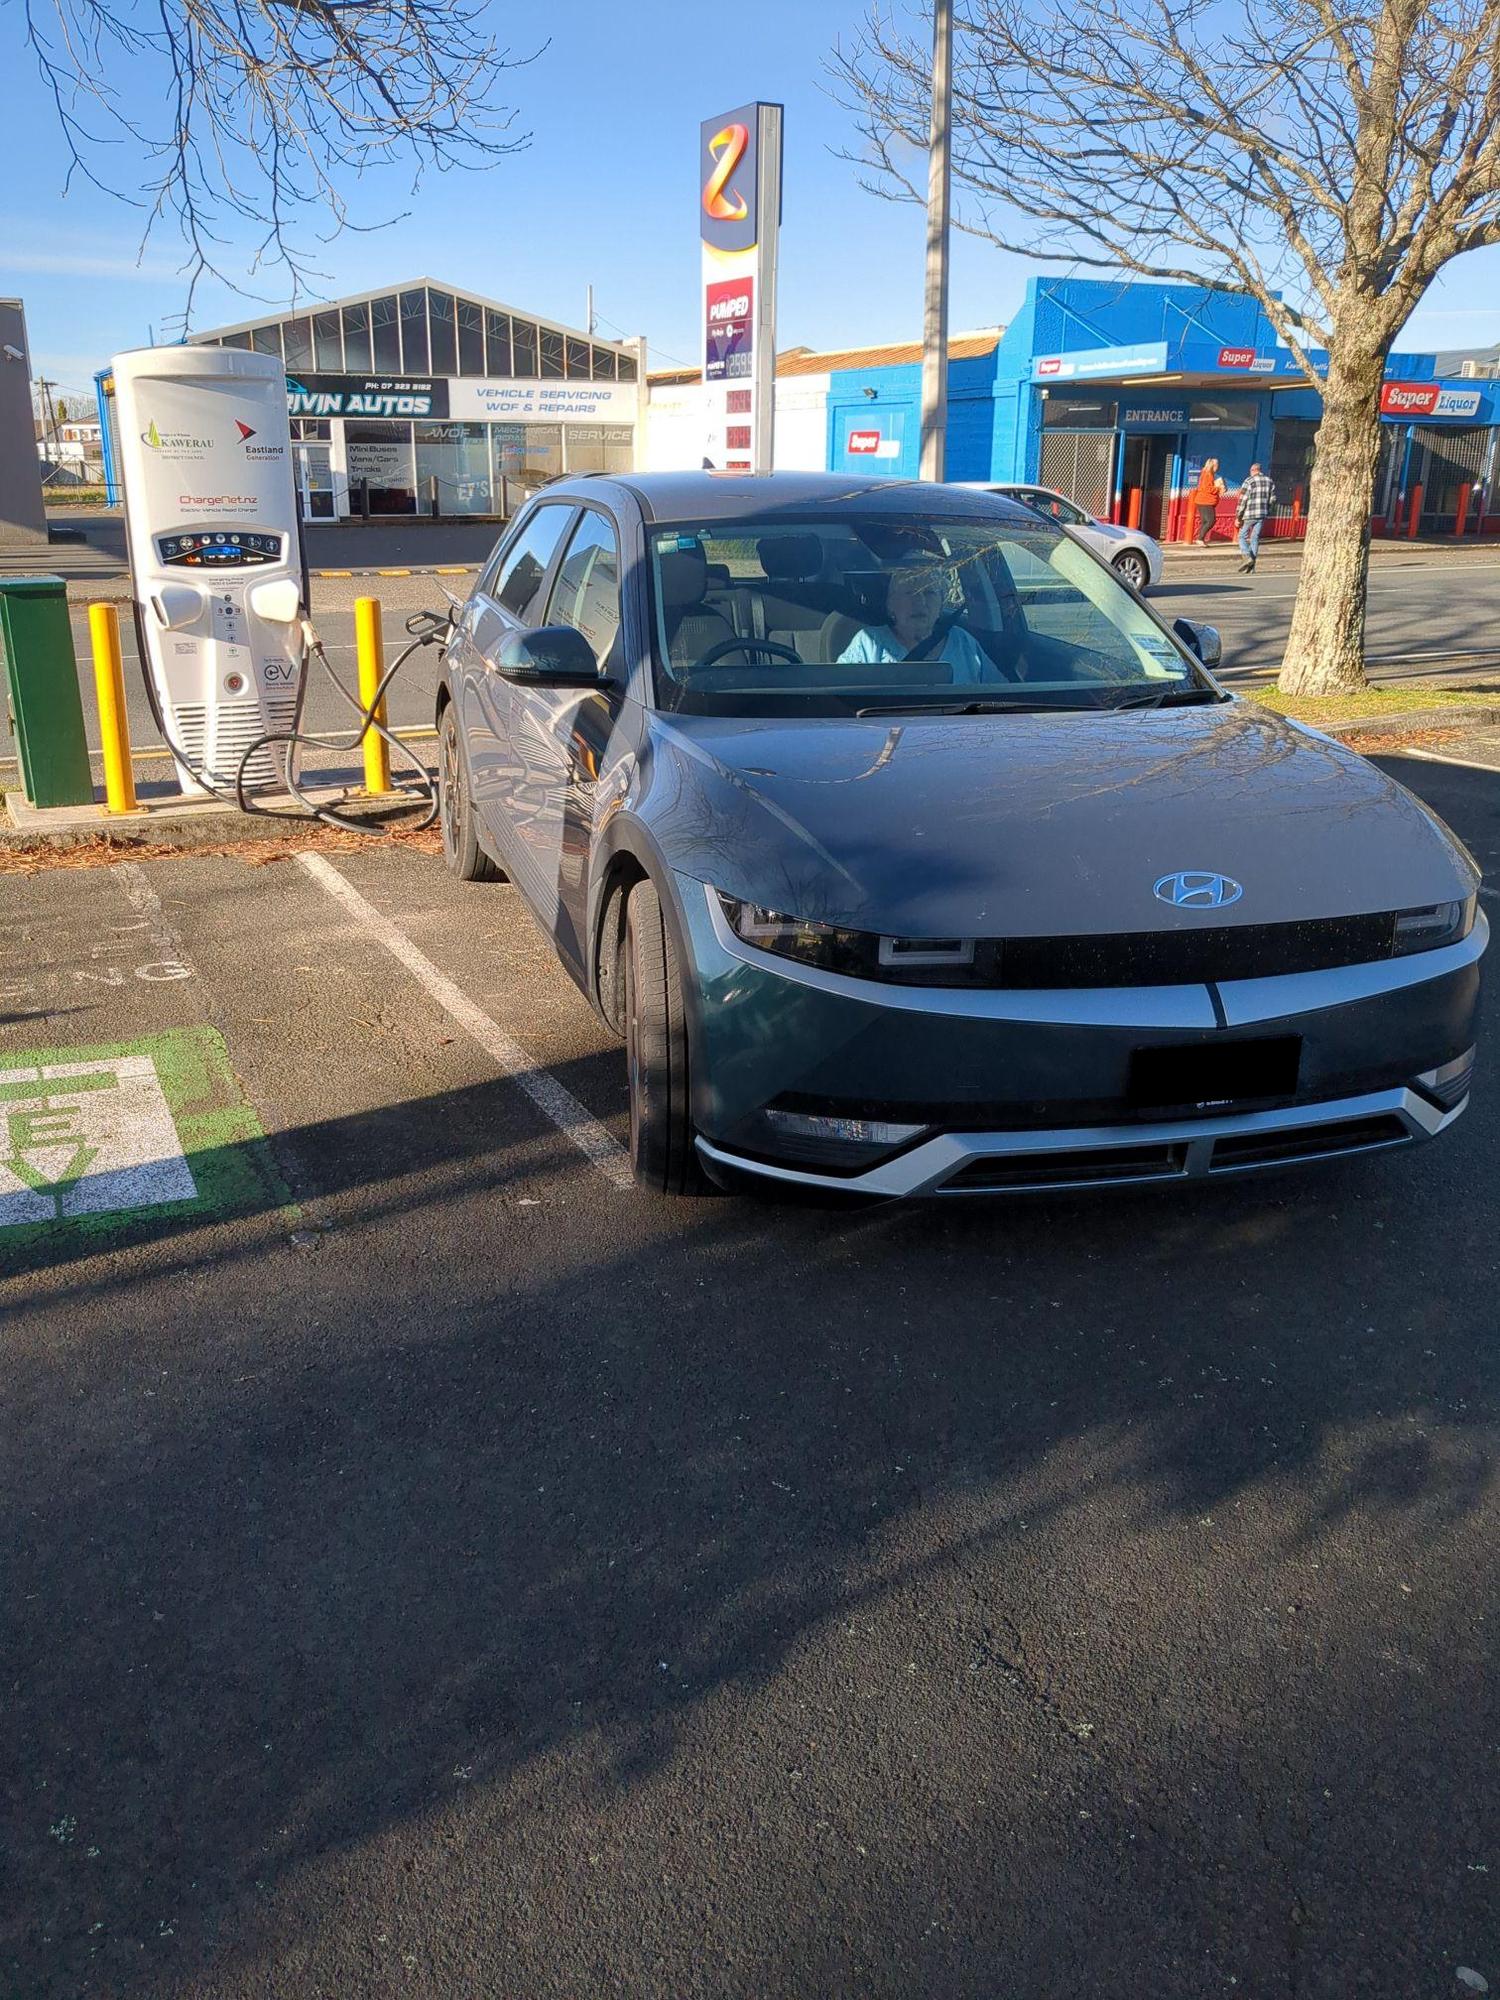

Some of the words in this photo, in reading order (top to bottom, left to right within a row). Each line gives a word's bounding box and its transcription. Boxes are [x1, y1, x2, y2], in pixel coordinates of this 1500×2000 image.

[710, 295, 749, 320] PUMPED
[1222, 351, 1252, 364] Super
[476, 388, 534, 398] VEHICLE
[540, 390, 612, 400] SERVICING
[1388, 387, 1433, 409] Super
[1439, 395, 1476, 411] Liquor
[345, 394, 431, 415] AUTOS
[486, 402, 520, 411] WOF
[523, 403, 533, 412] &
[539, 403, 597, 413] REPAIRS
[1126, 410, 1184, 421] ENTRANCE
[568, 430, 631, 440] SERVICE
[161, 439, 215, 448] KAWERAU
[246, 445, 284, 454] Eastland
